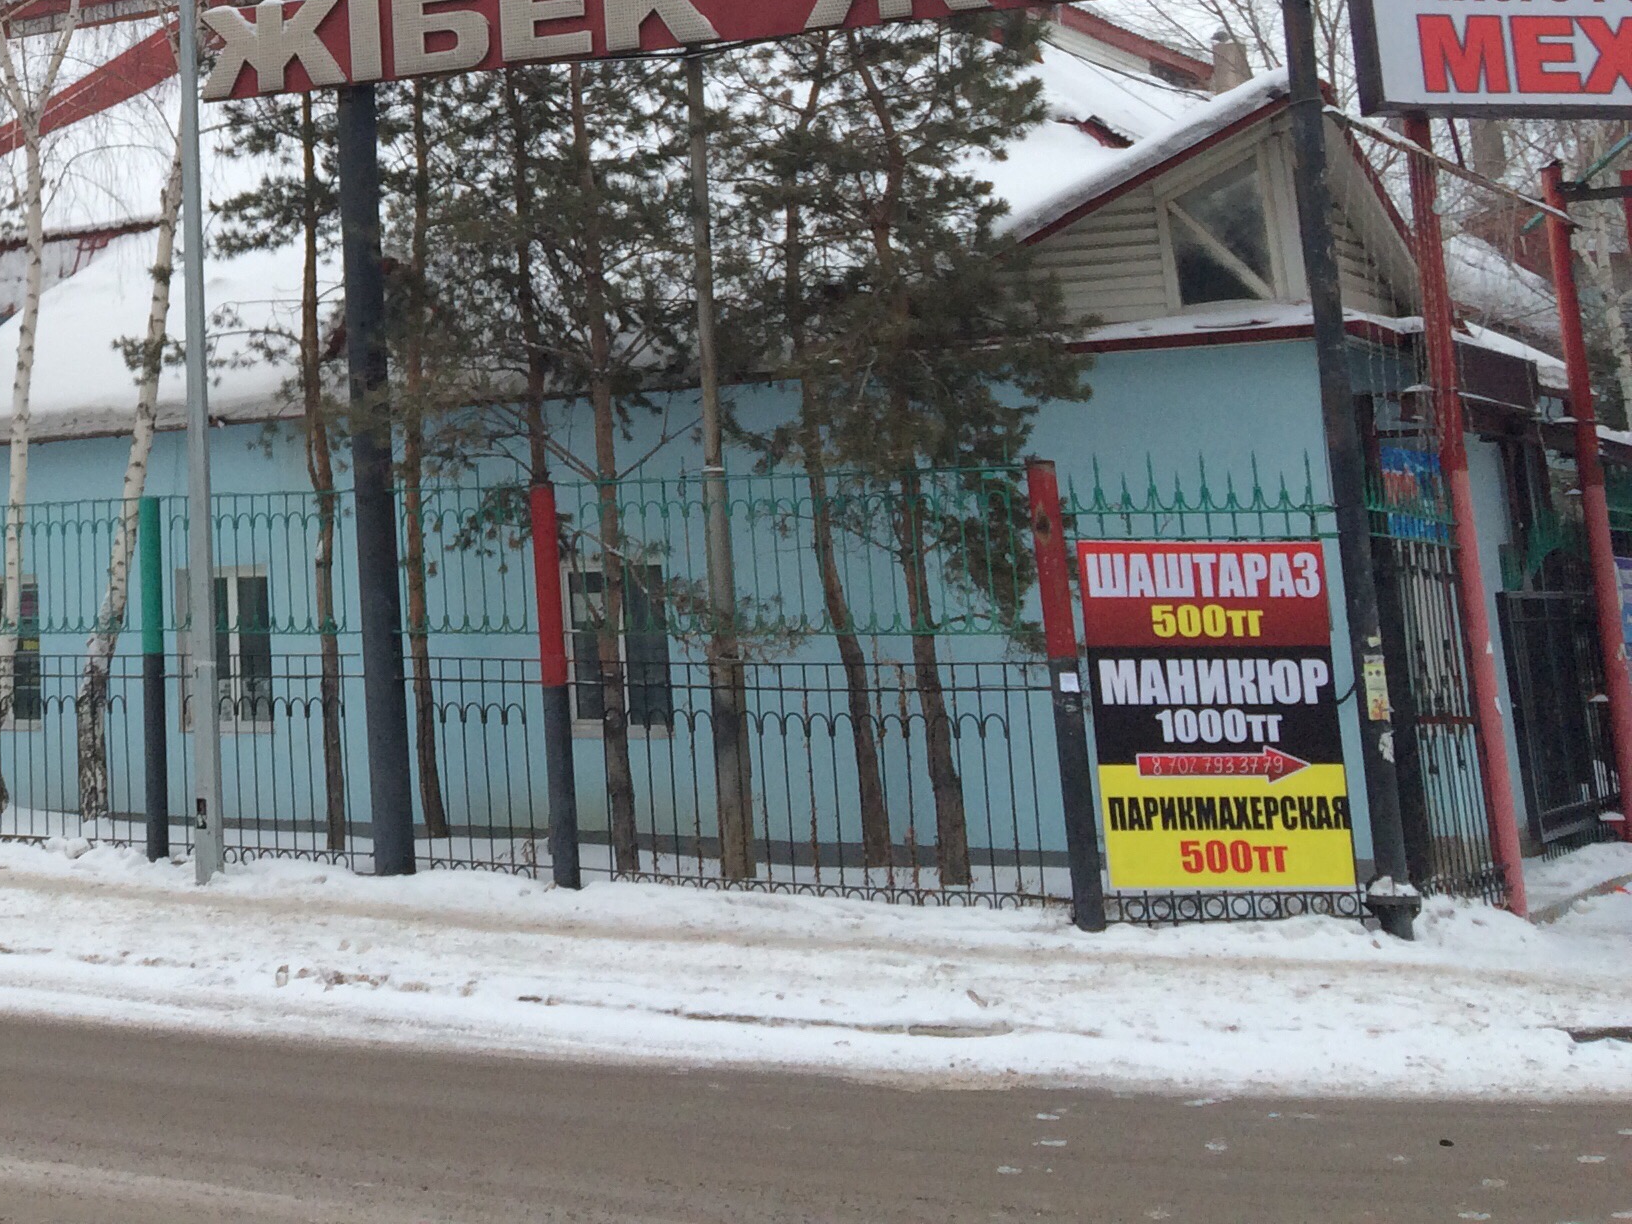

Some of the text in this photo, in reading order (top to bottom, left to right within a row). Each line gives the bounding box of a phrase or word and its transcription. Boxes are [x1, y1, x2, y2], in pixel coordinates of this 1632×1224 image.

[1085, 552, 1321, 598] ШАШТАРАЗ
[1151, 604, 1264, 638] 500тг
[1098, 659, 1329, 705] МАНИКЮР
[1155, 708, 1283, 743] 1000тг
[1151, 756, 1162, 775] 8
[1108, 796, 1350, 831] ПАРИКМАХЕРСКАЯ
[1180, 840, 1288, 874] 500тг
